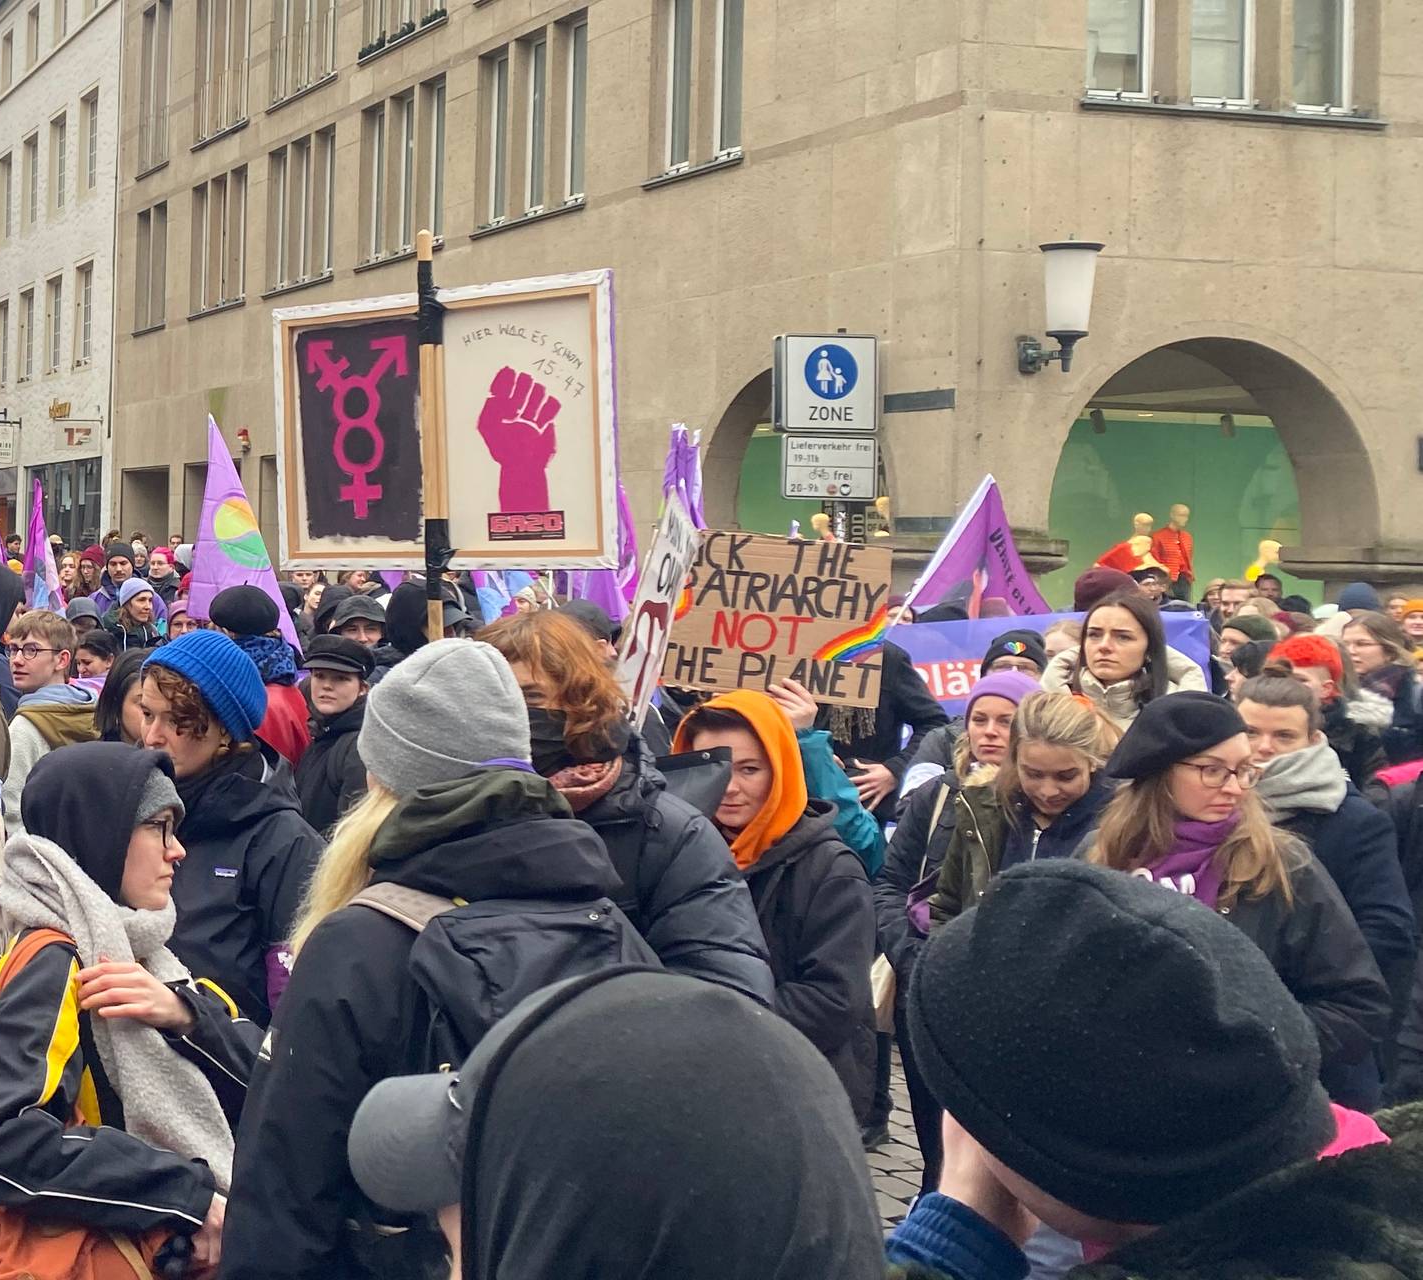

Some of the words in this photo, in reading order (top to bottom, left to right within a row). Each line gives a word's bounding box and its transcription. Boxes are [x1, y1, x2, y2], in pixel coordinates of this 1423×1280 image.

[462, 328, 492, 345] HIER
[532, 330, 548, 346] ES
[809, 406, 854, 421] ZONE
[790, 441, 852, 451] Lieferverkehr
[855, 442, 871, 452] frei
[833, 470, 853, 481] frei
[787, 540, 866, 580] THE
[711, 610, 816, 655] NOT
[661, 642, 724, 684] THE
[737, 652, 882, 699] PLANET
